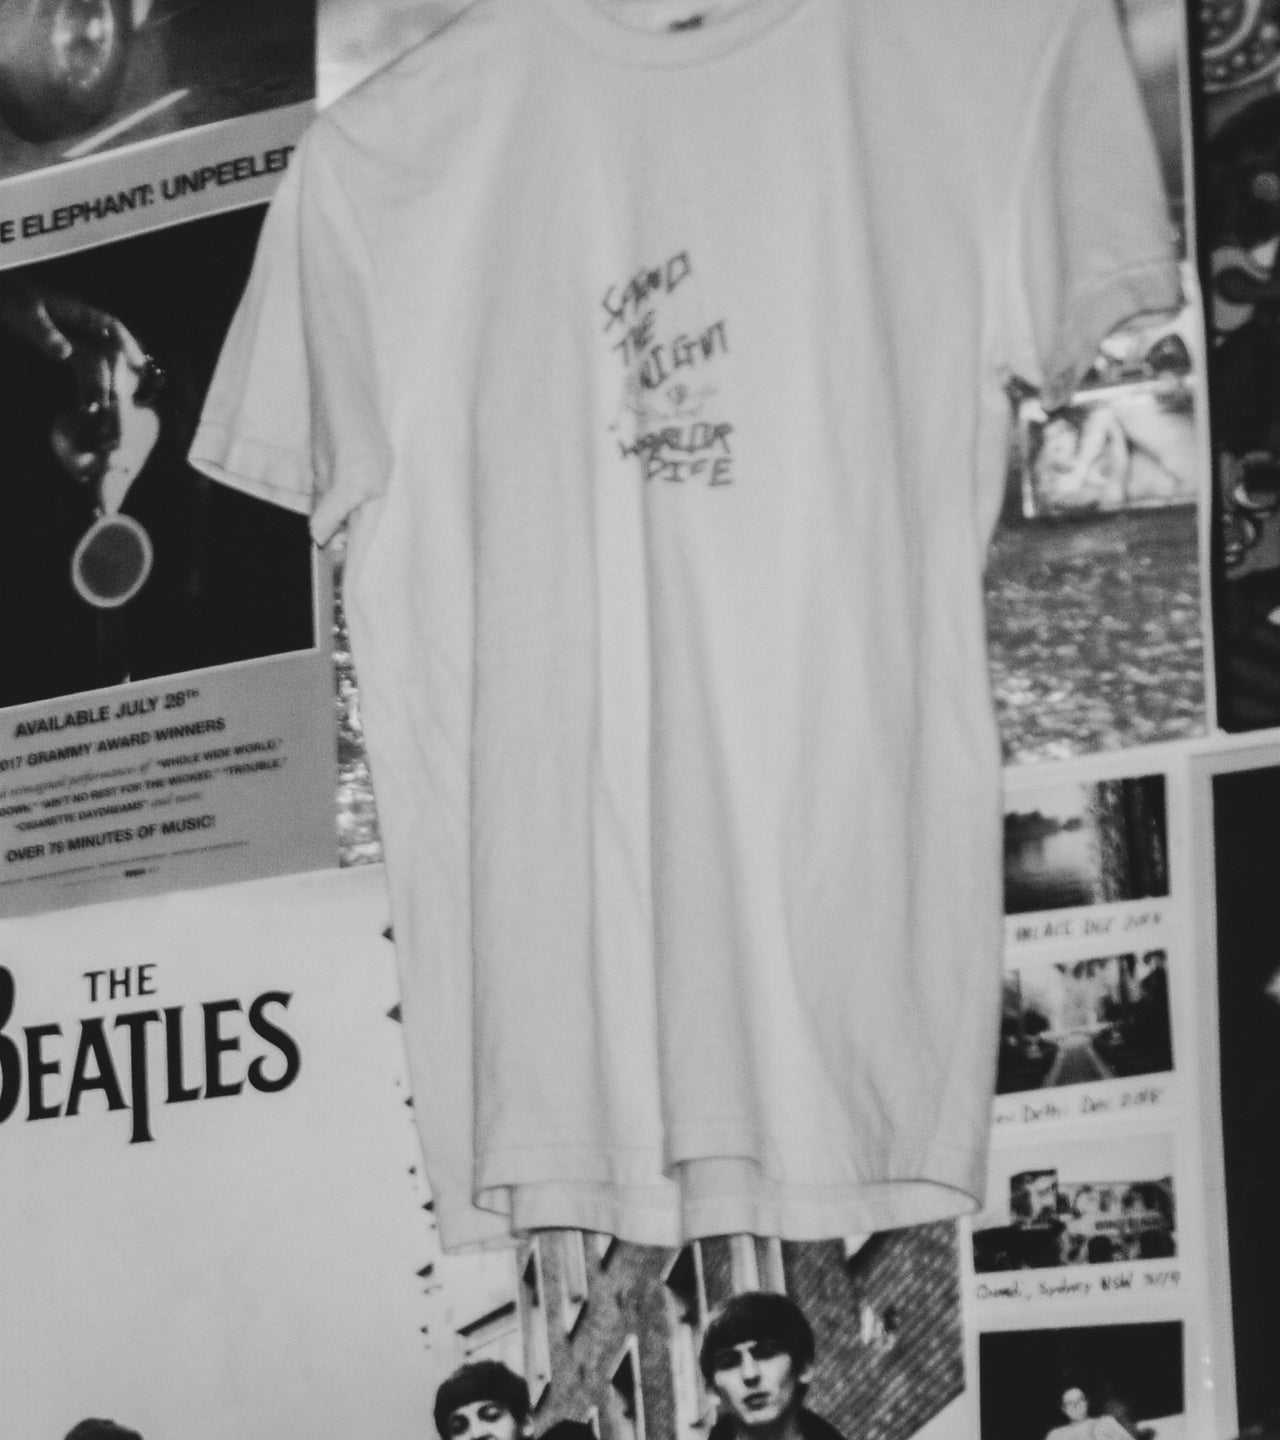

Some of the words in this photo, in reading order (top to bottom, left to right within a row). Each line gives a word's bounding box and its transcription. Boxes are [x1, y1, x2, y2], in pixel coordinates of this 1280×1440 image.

[13, 704, 112, 738] AVAILABLE
[115, 696, 160, 719] JULY
[26, 742, 93, 767] GRAMMY
[96, 730, 151, 753] AWARD
[154, 716, 227, 742] WINNERS
[4, 844, 45, 863] OVER
[67, 828, 134, 852] MINUTES
[137, 823, 157, 840] OF
[82, 963, 159, 1003] THE
